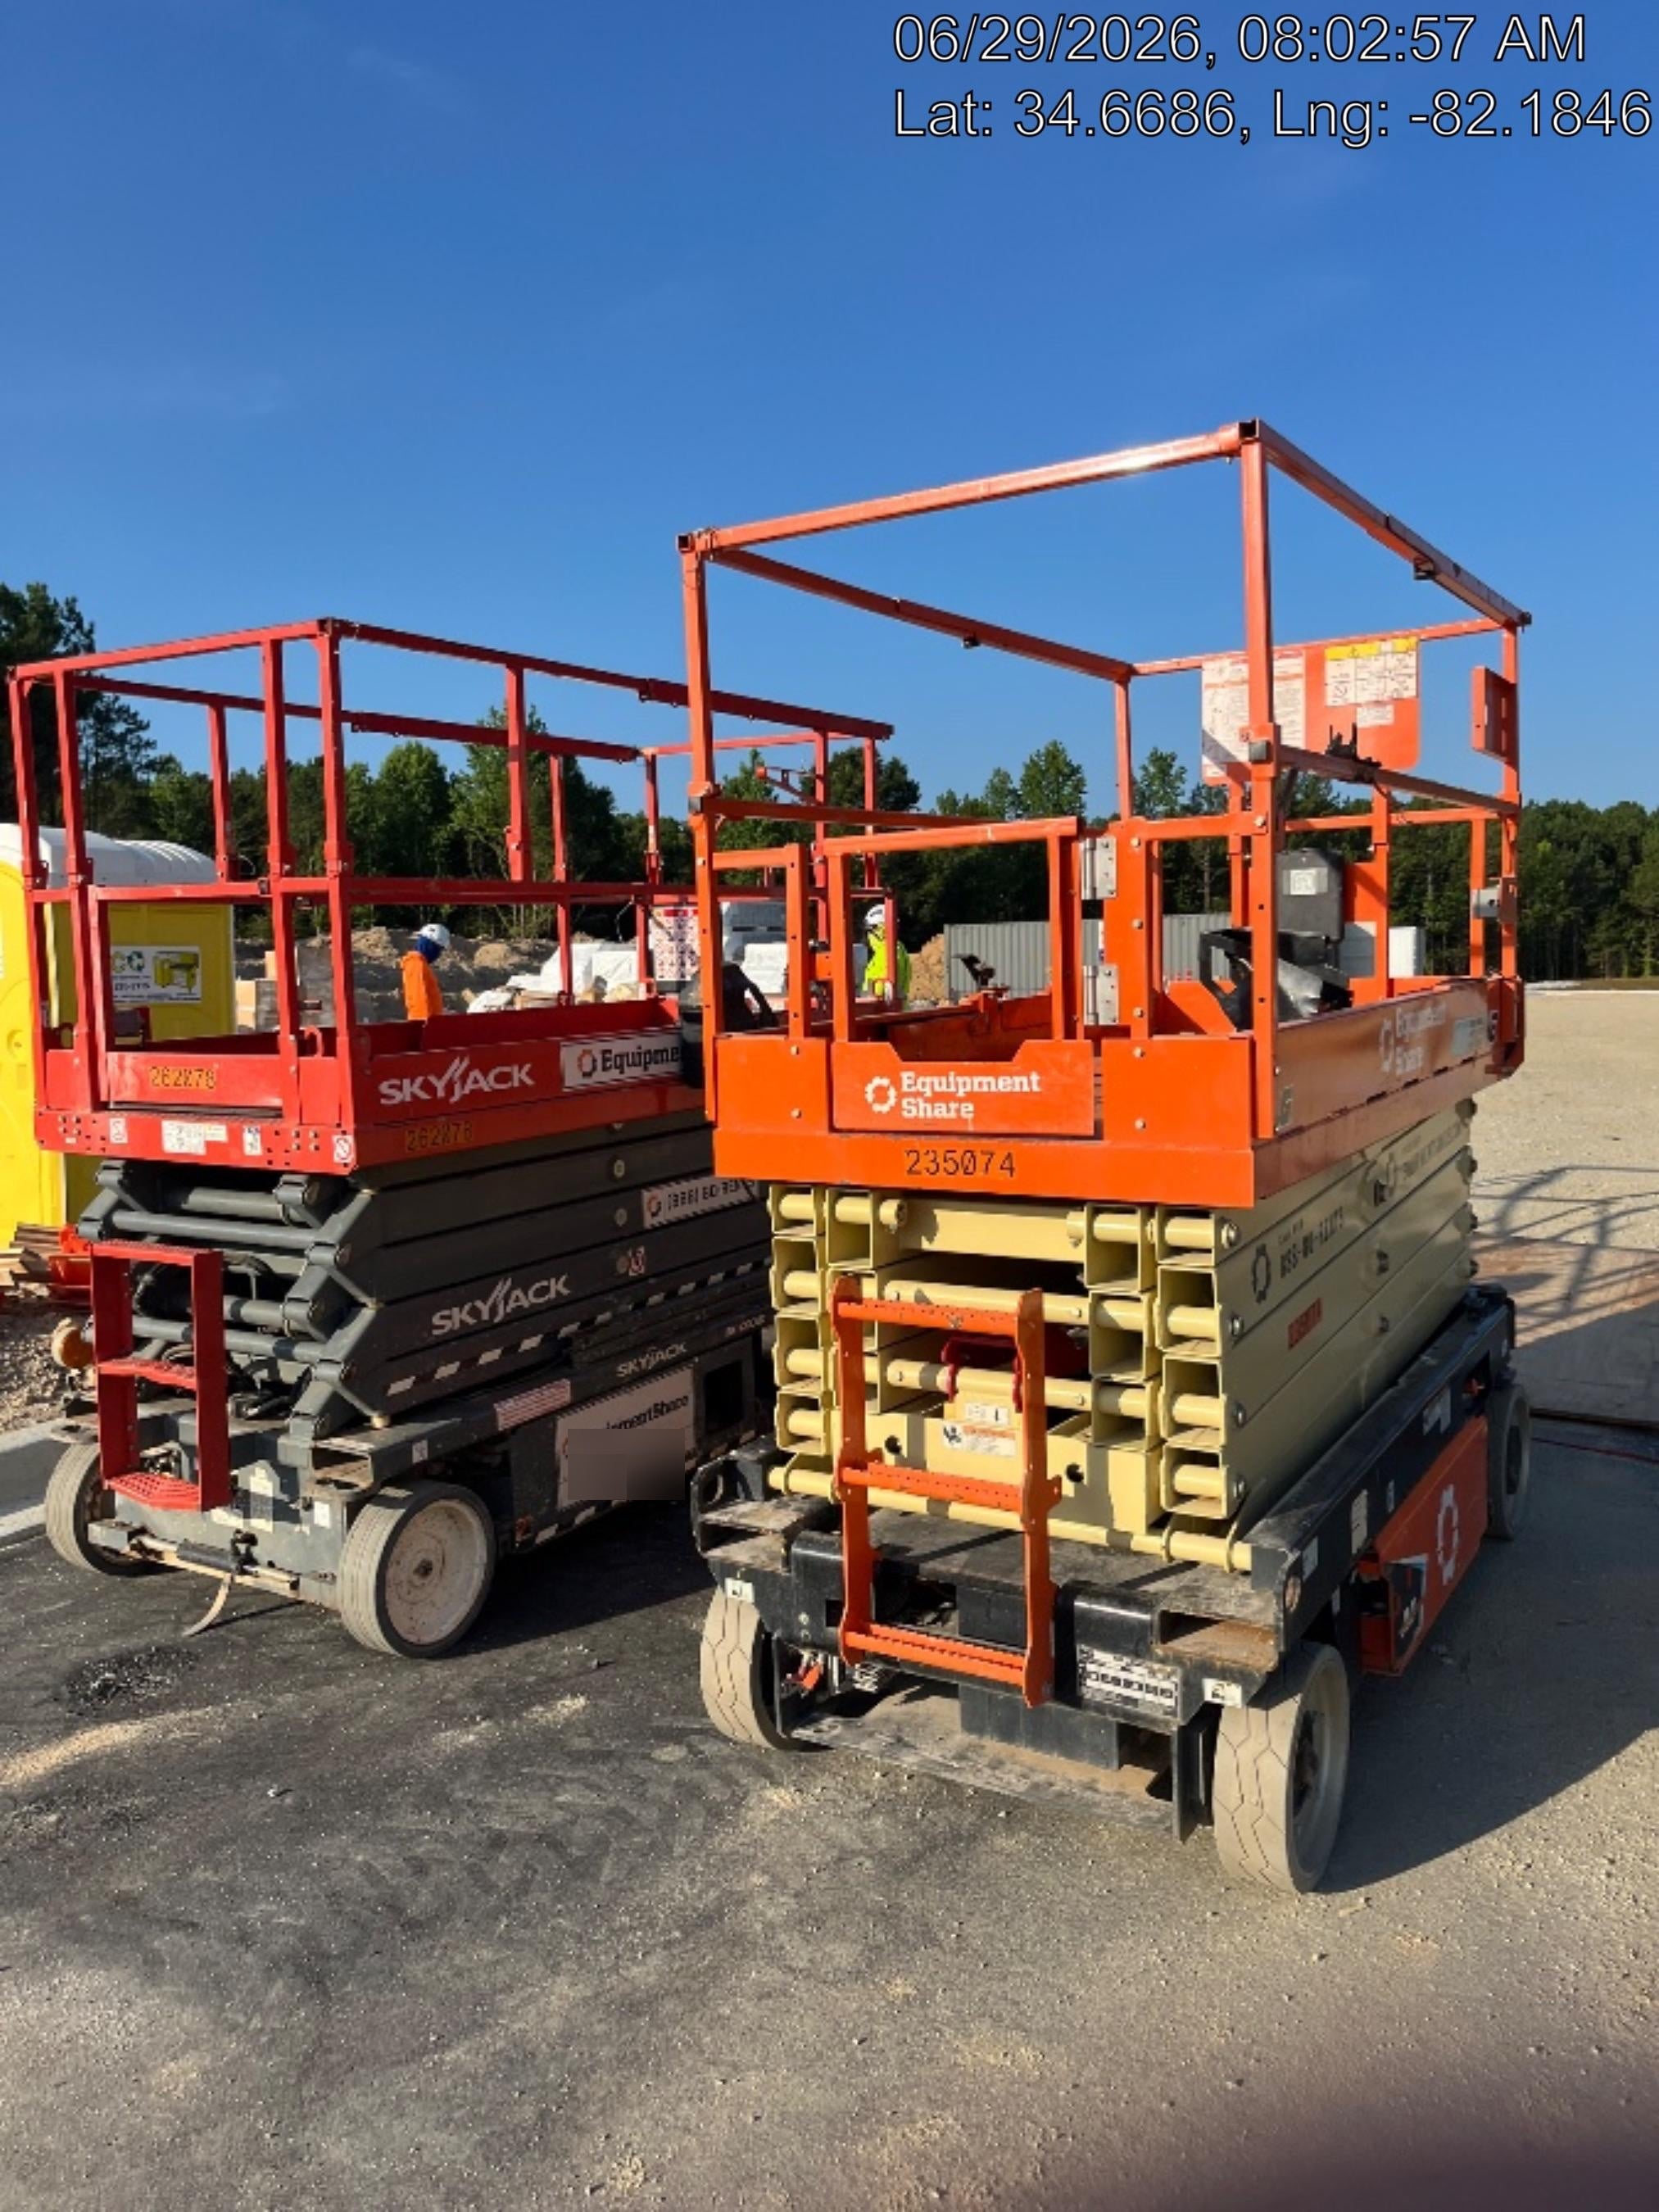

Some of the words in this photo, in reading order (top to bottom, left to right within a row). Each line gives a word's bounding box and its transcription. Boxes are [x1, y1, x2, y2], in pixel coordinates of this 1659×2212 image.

[378, 1054, 536, 1105] SKYJACK
[900, 1071, 1042, 1097] Equipment
[901, 1098, 975, 1119] Share
[905, 1149, 1017, 1178] 235074
[431, 1272, 572, 1336] SKYJACK
